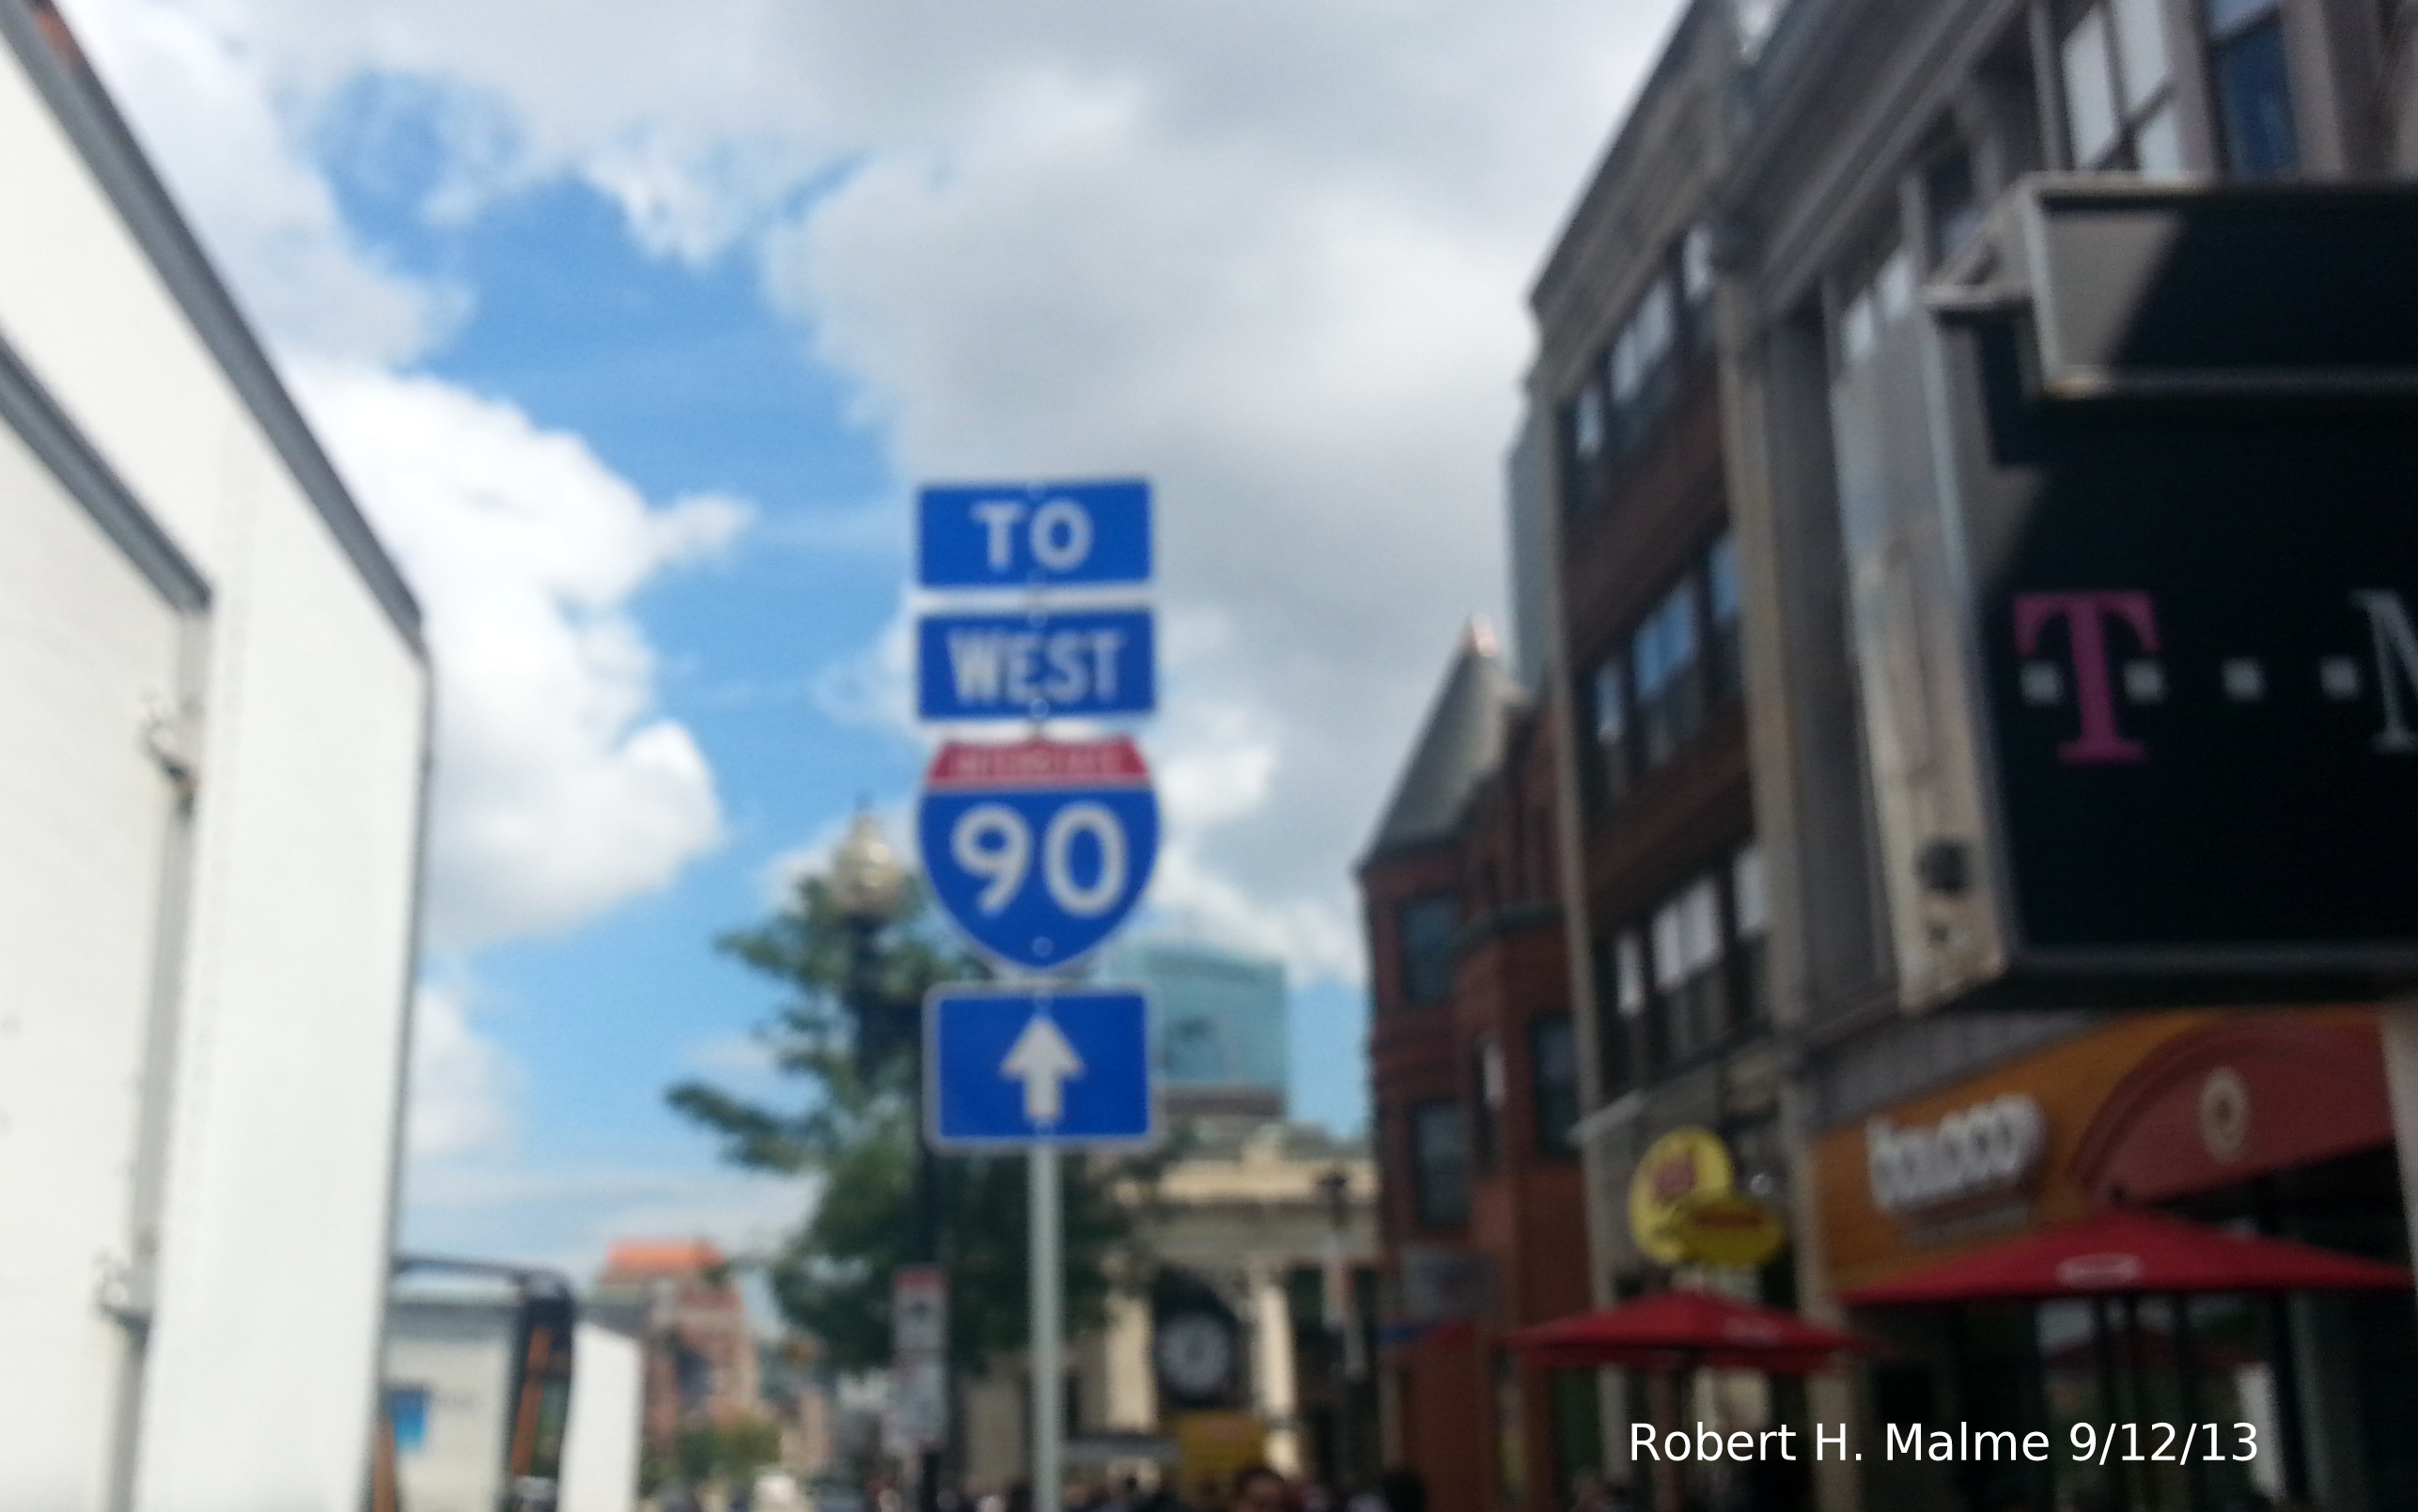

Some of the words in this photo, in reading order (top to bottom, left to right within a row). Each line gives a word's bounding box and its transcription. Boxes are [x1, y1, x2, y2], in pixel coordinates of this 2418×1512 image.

[972, 499, 1093, 569] TO
[948, 628, 1124, 705] WEST
[951, 803, 1130, 915] 90
